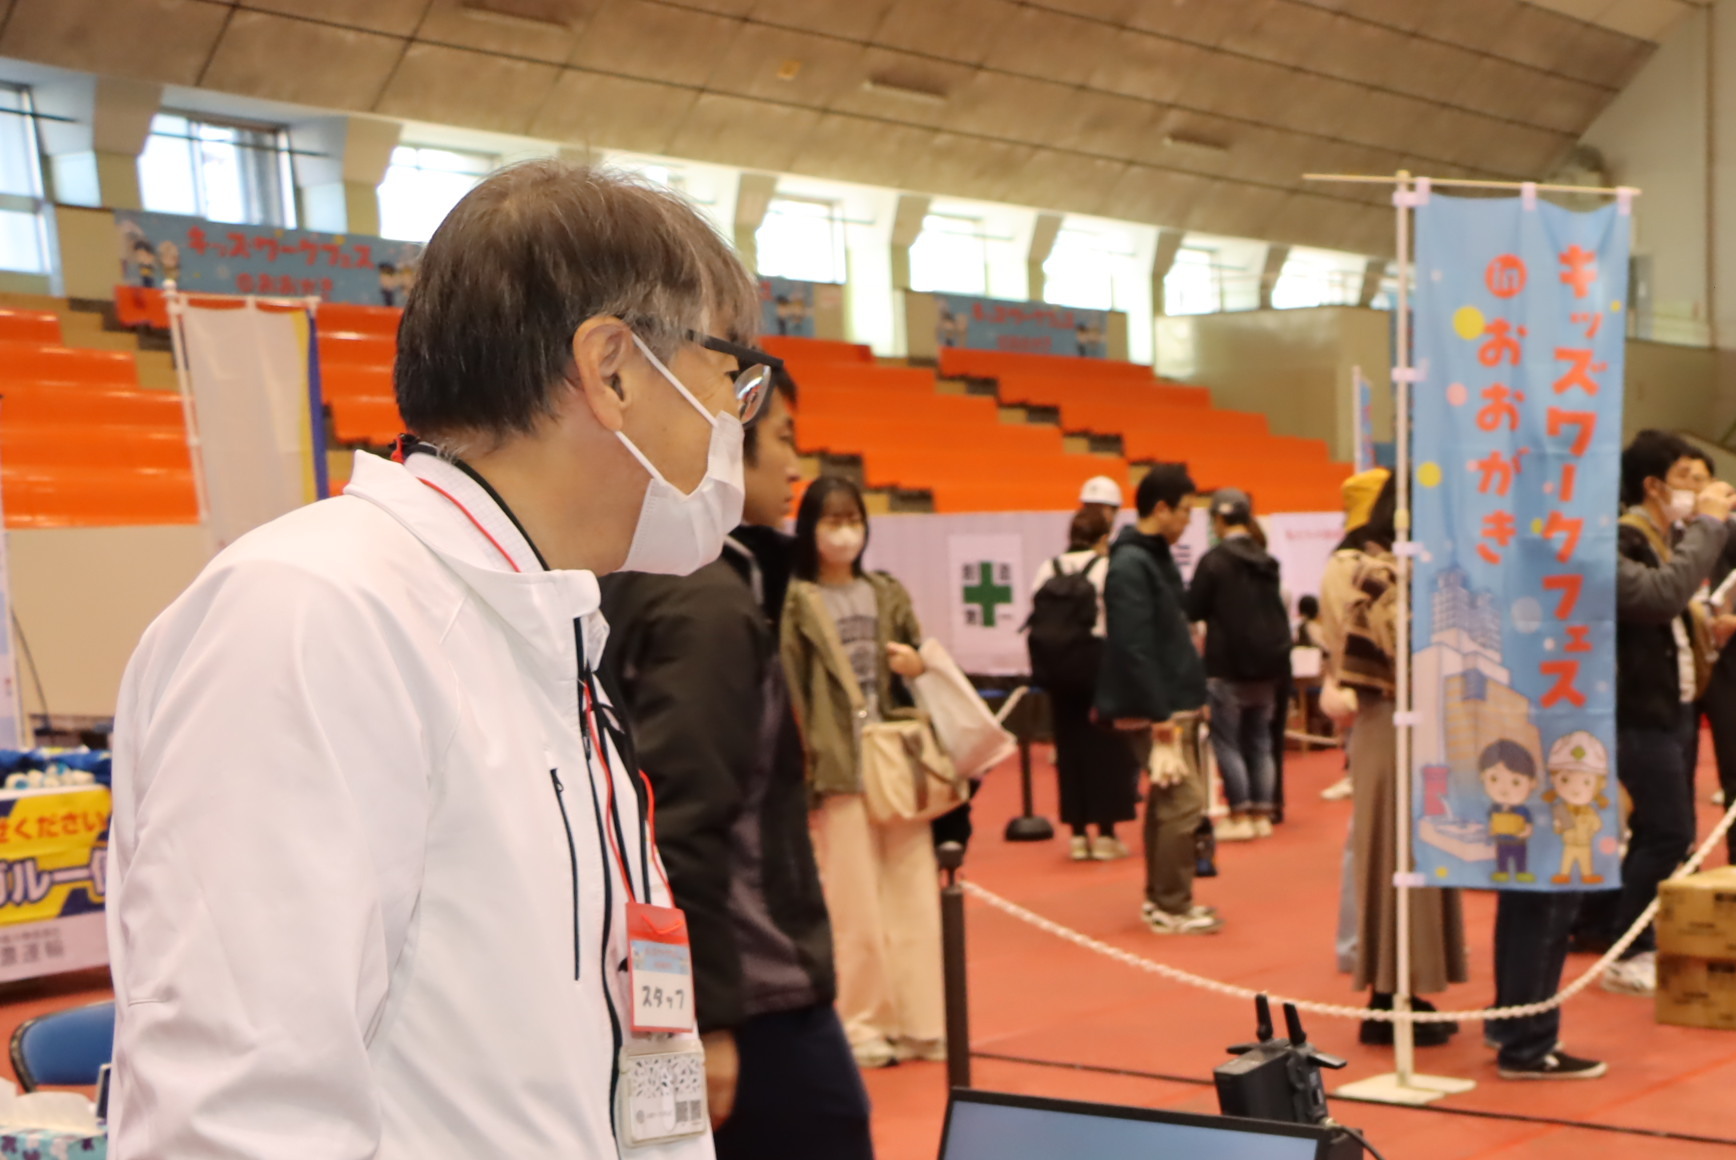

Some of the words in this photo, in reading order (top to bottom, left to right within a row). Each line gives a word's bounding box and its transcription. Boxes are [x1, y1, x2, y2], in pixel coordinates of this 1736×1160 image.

[1475, 320, 1527, 564] おおがき
[1539, 245, 1606, 707] キッズワークフェス
[0, 848, 105, 905] ルー
